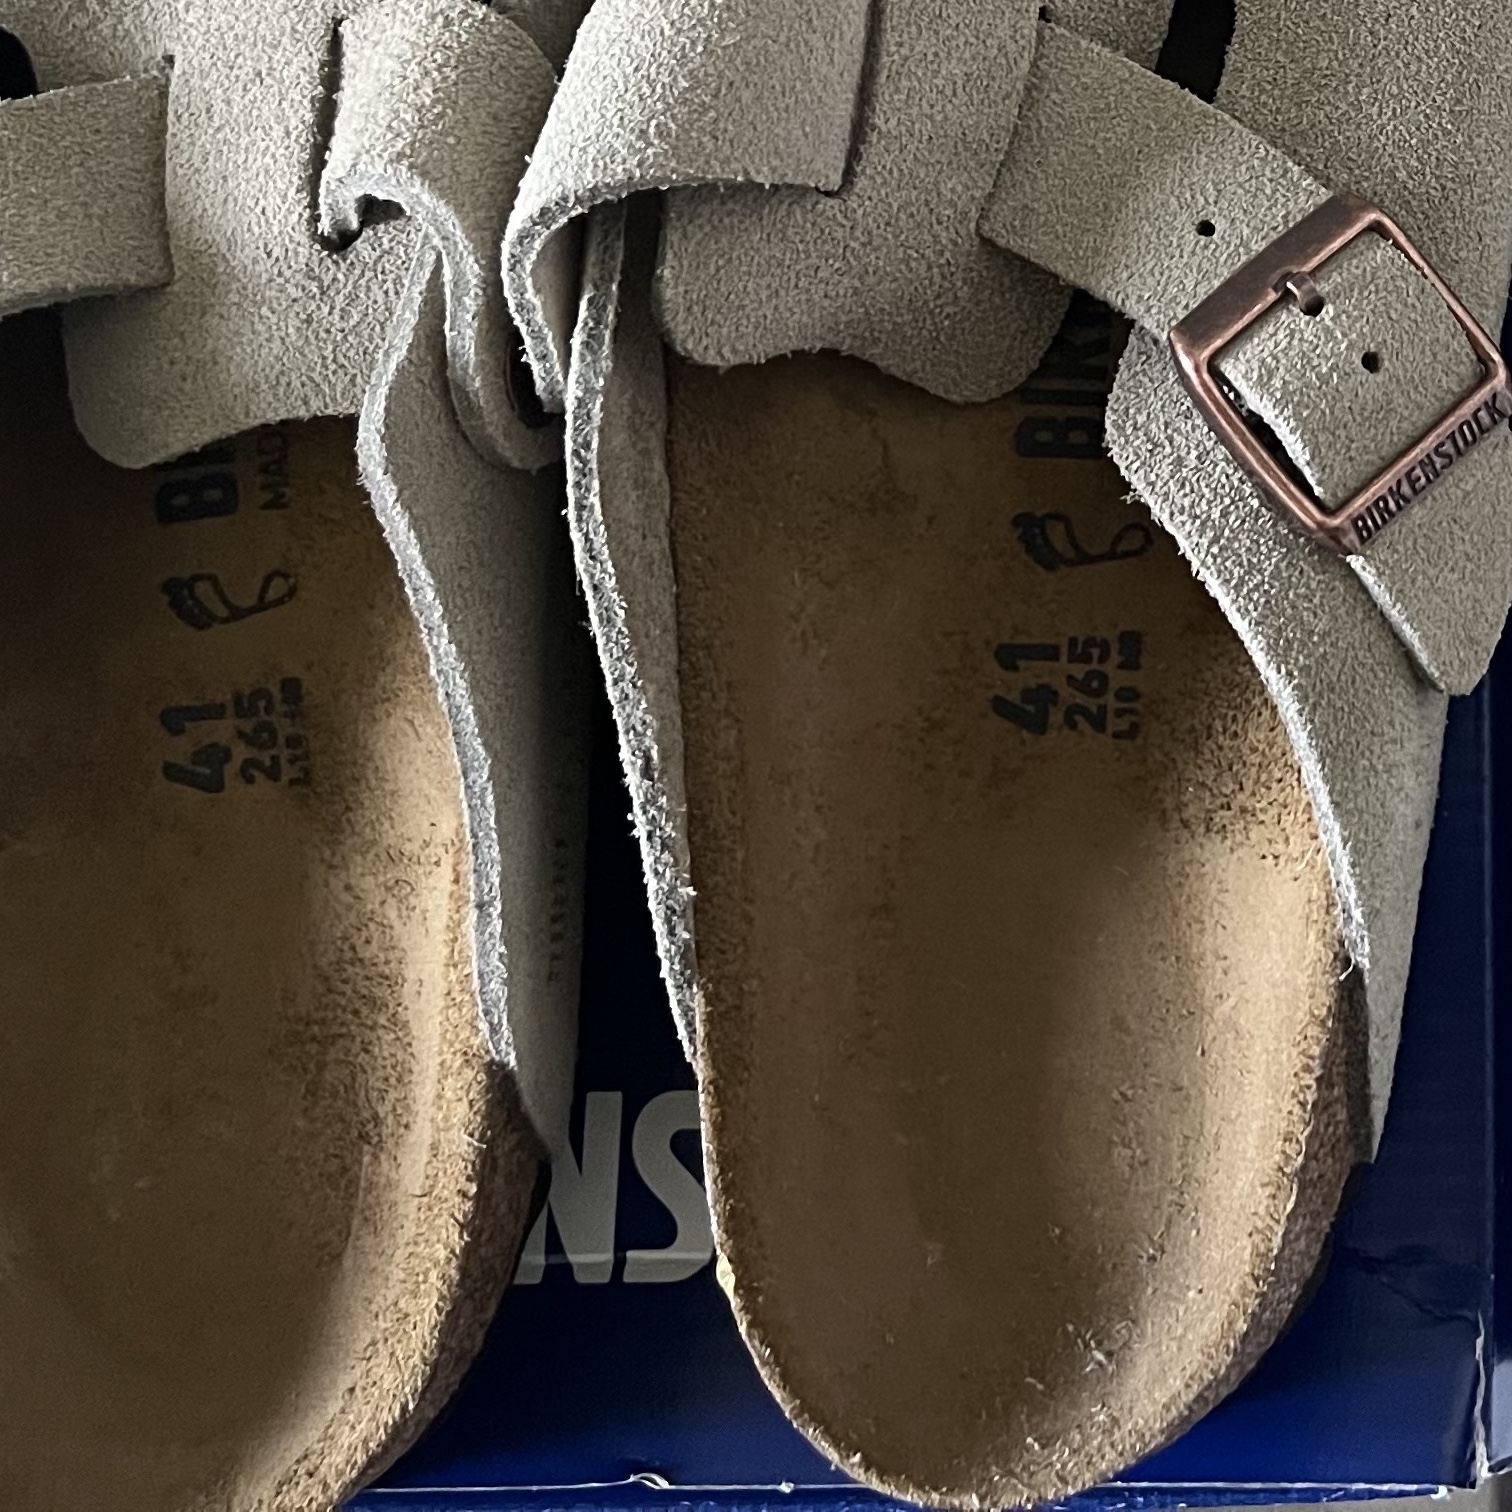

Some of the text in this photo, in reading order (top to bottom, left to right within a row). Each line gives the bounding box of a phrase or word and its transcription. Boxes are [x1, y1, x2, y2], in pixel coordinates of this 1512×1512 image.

[1352, 391, 1503, 545] BIRKENSTOCK
[988, 642, 1060, 736] 41
[1063, 635, 1111, 734] 265
[159, 701, 232, 793] 41
[233, 687, 281, 784] 265
